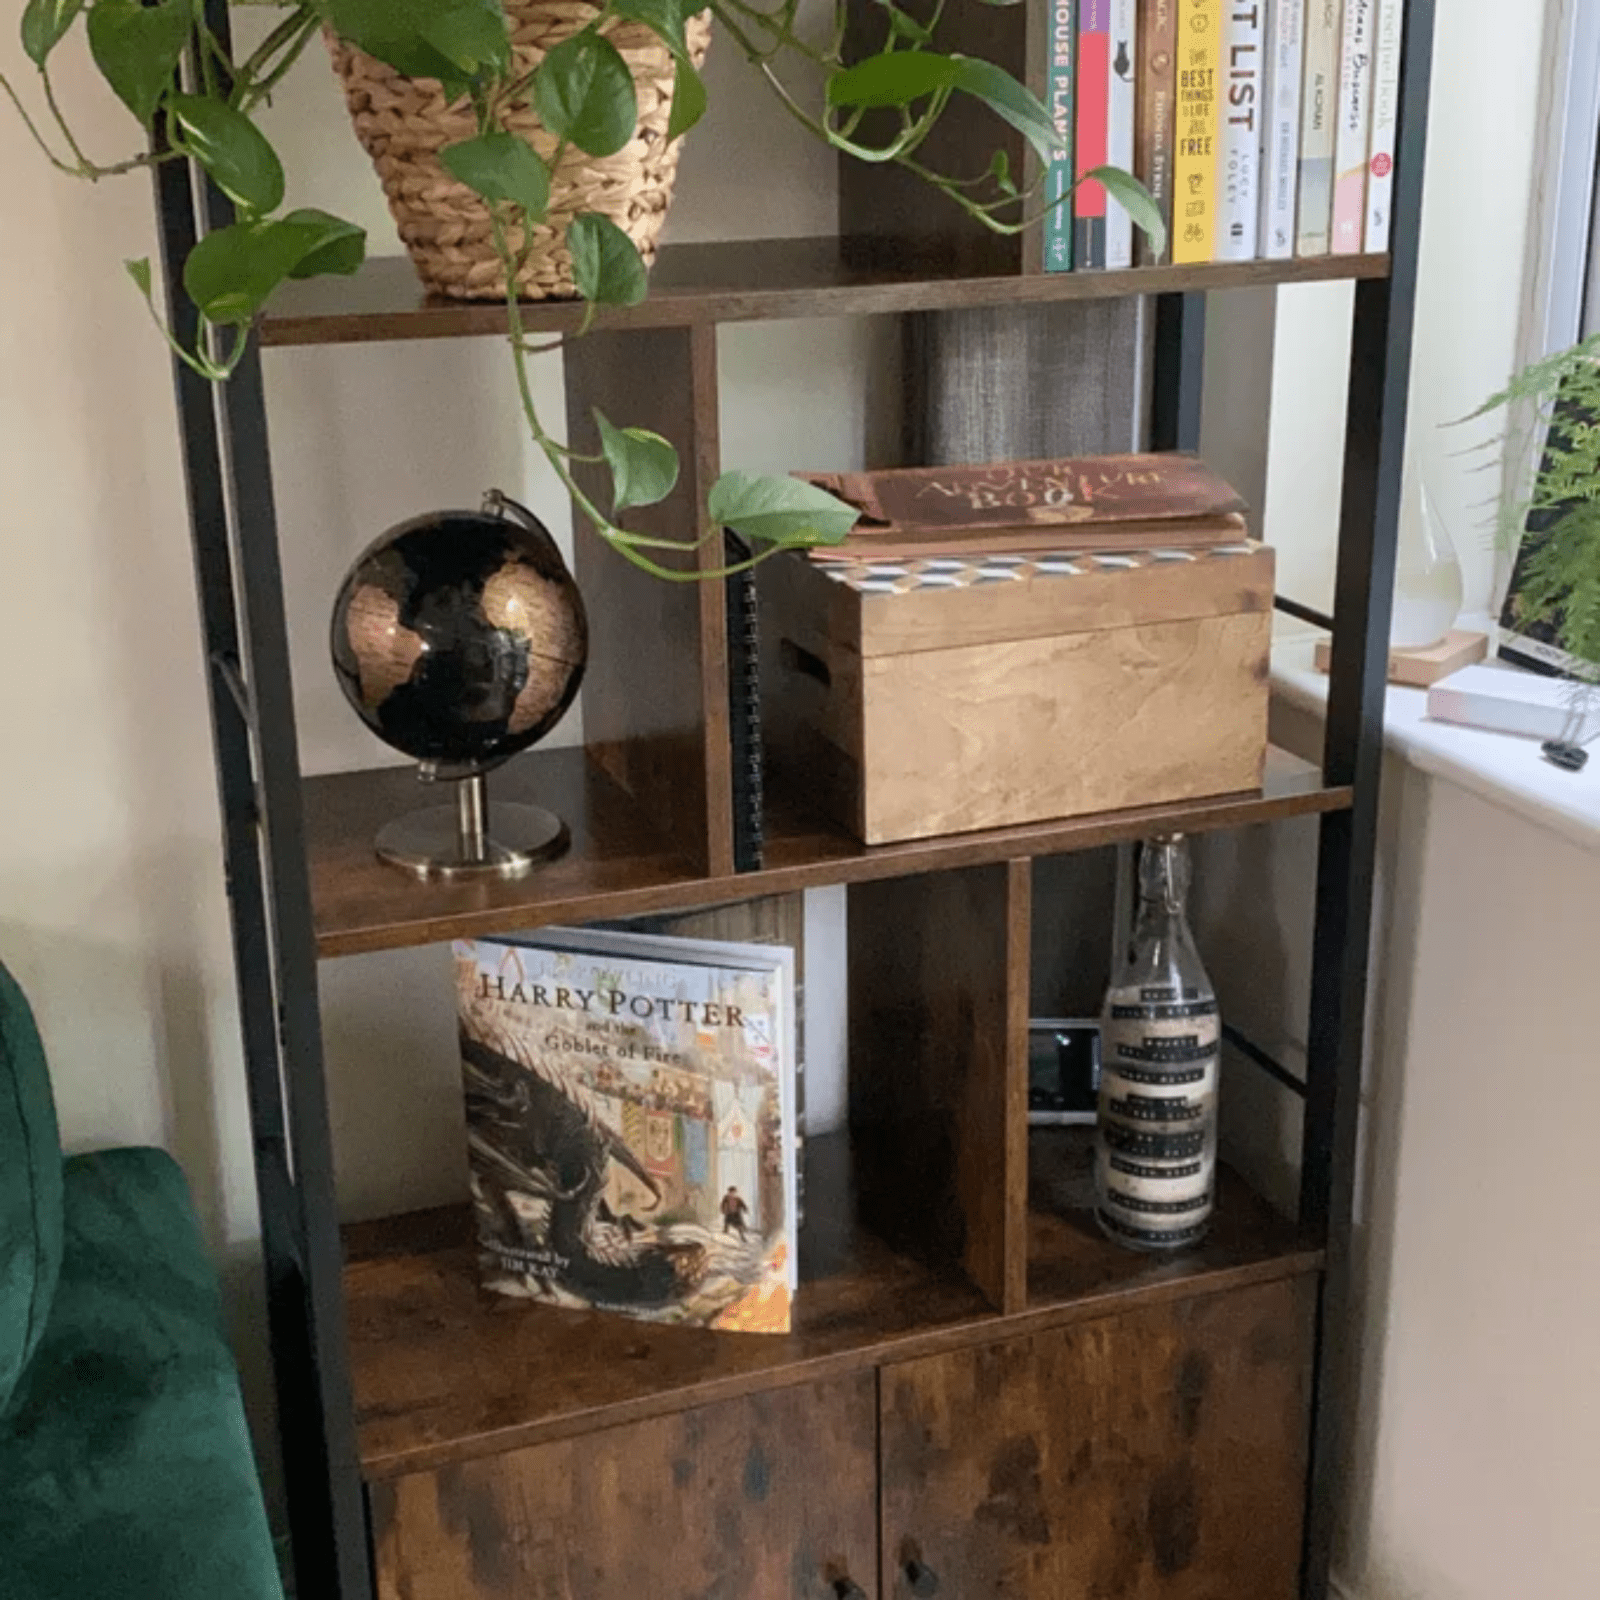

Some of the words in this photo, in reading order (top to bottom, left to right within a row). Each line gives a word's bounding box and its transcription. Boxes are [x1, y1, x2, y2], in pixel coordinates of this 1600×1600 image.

[1181, 68, 1214, 88] BEST
[1227, 45, 1257, 132] LIST
[1180, 136, 1212, 157] FREE
[1227, 149, 1239, 204] FOLEY
[1240, 154, 1251, 198] LUCY
[477, 973, 597, 1012] HARRY
[608, 990, 746, 1027] POTTER
[586, 1020, 610, 1034] and
[615, 1022, 638, 1036] the
[544, 1035, 608, 1057] Goblet
[617, 1043, 636, 1060] of
[644, 1047, 682, 1065] Fire
